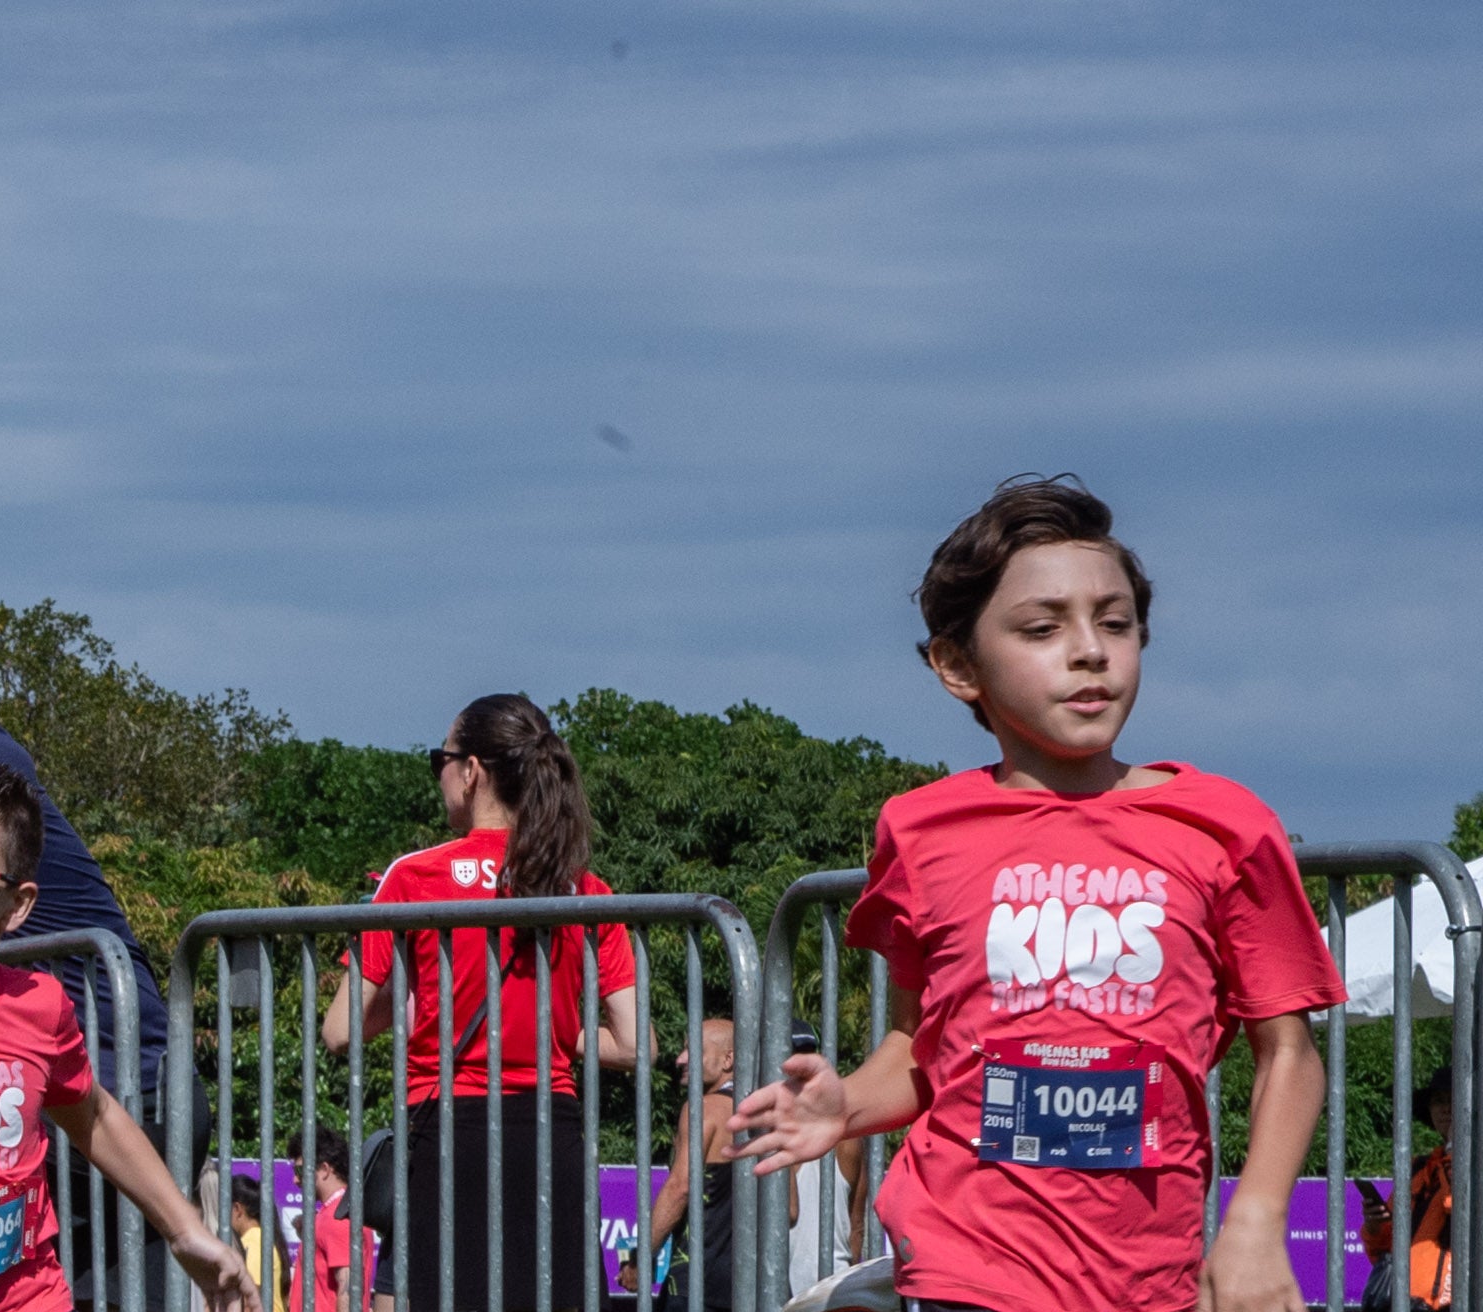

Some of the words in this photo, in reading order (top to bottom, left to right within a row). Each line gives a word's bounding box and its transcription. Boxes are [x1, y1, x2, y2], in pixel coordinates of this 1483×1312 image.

[992, 863, 1168, 907] ATHENAS
[986, 897, 1166, 990] KIDS
[1053, 980, 1157, 1016] FASTER
[985, 1066, 1018, 1079] 250m
[1033, 1085, 1138, 1118] 10044
[983, 1114, 1014, 1129] 2016
[1291, 1230, 1358, 1240] MINISIO
